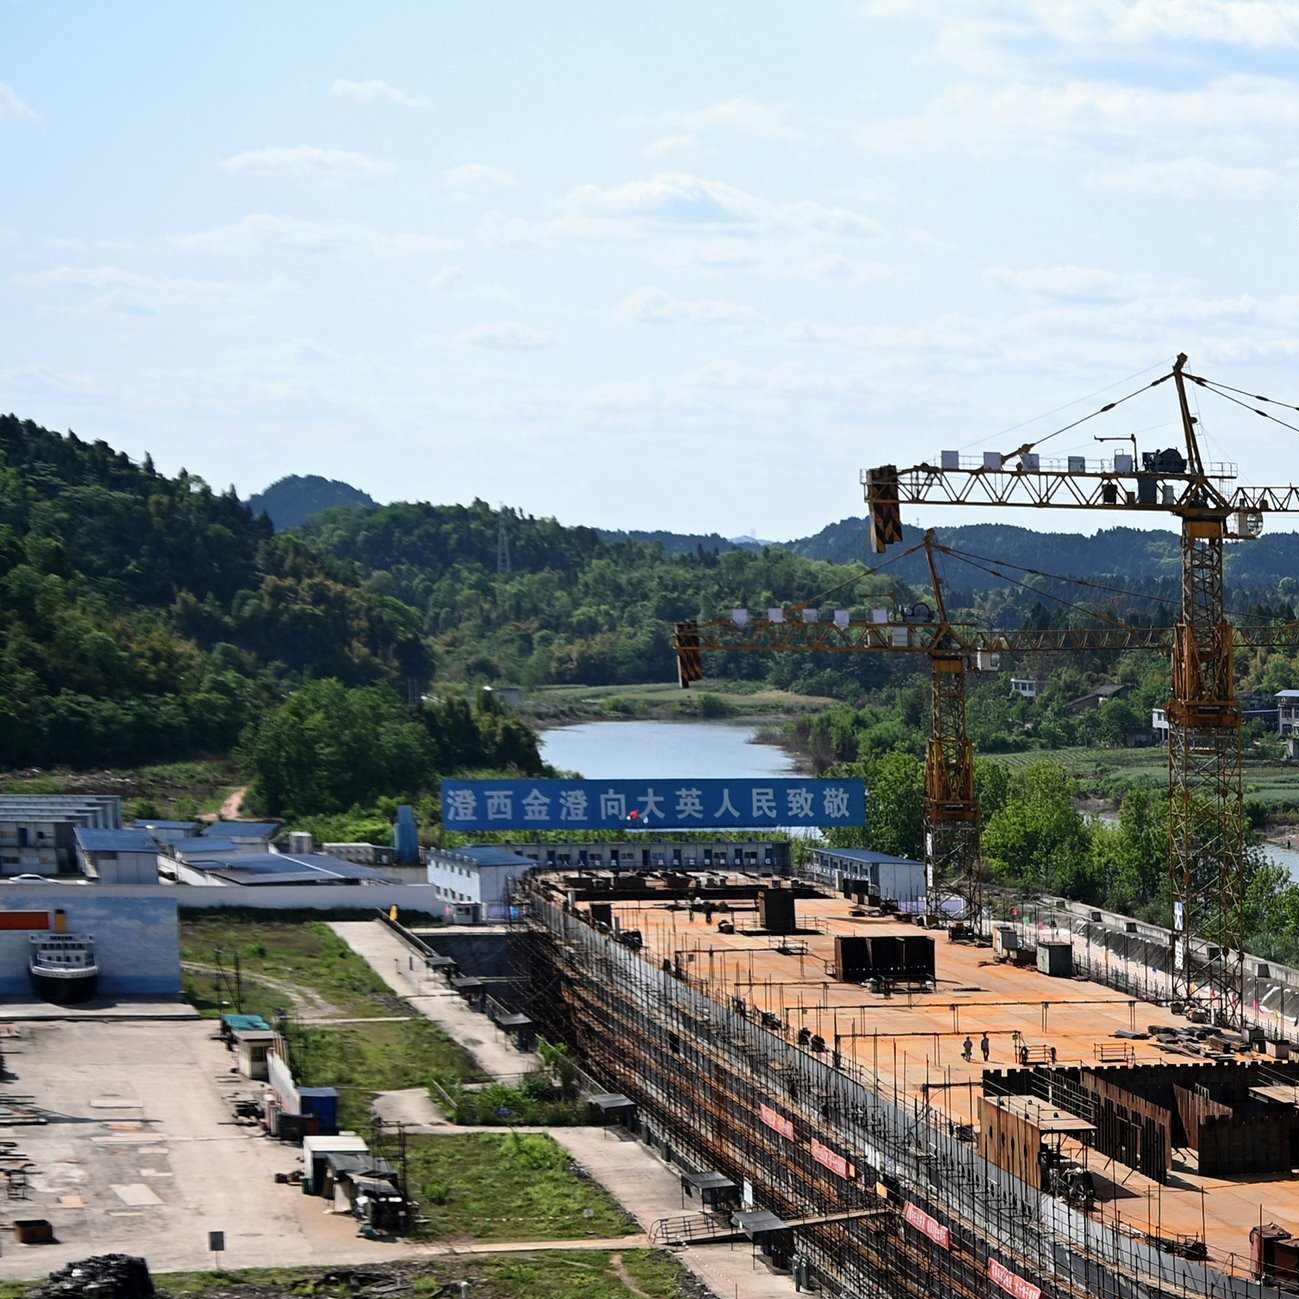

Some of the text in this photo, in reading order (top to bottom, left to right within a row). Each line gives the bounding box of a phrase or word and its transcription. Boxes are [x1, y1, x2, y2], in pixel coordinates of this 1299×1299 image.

[446, 787, 851, 821] 澄西金澄向大英人民致敬
